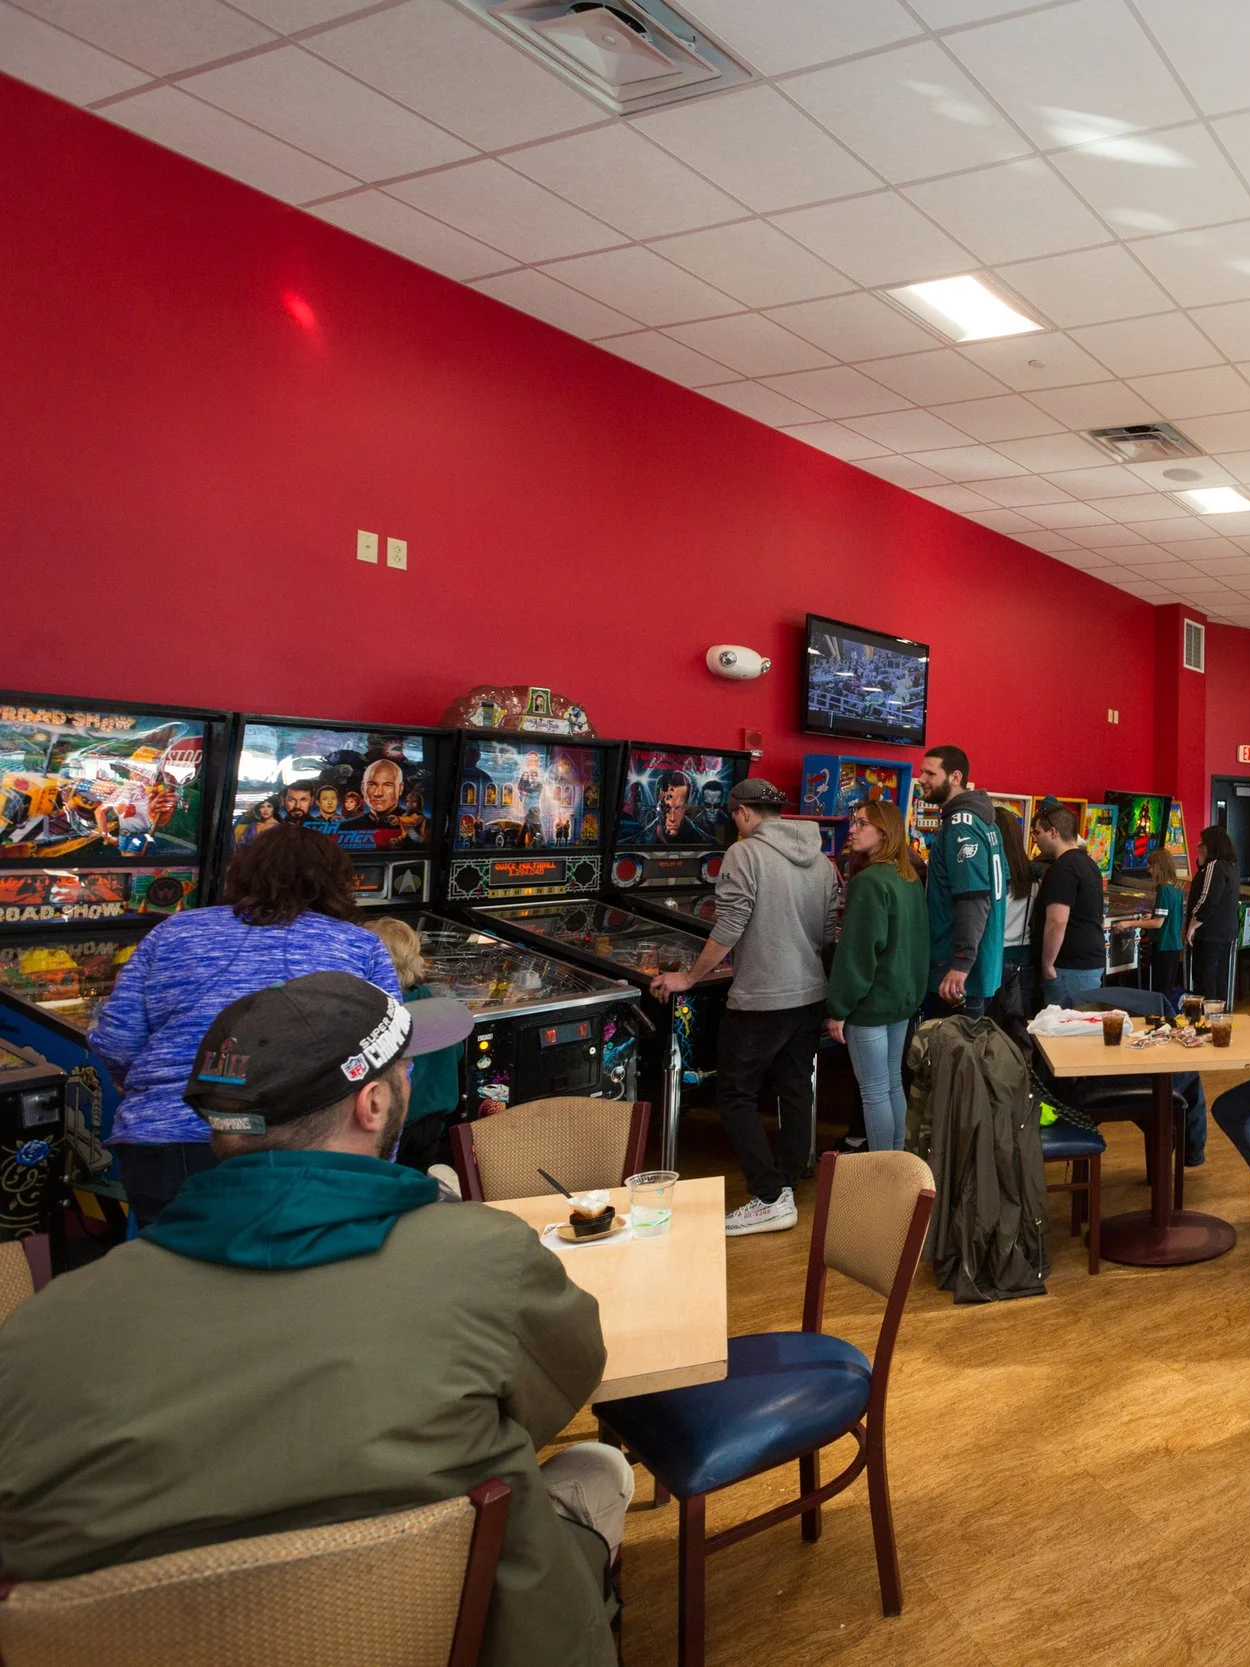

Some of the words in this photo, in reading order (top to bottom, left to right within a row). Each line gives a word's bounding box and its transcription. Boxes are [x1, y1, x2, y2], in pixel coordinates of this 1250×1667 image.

[72, 711, 134, 732] SHOW
[166, 749, 202, 767] STOP
[62, 901, 122, 921] SHOW
[359, 1016, 392, 1050] SUPER
